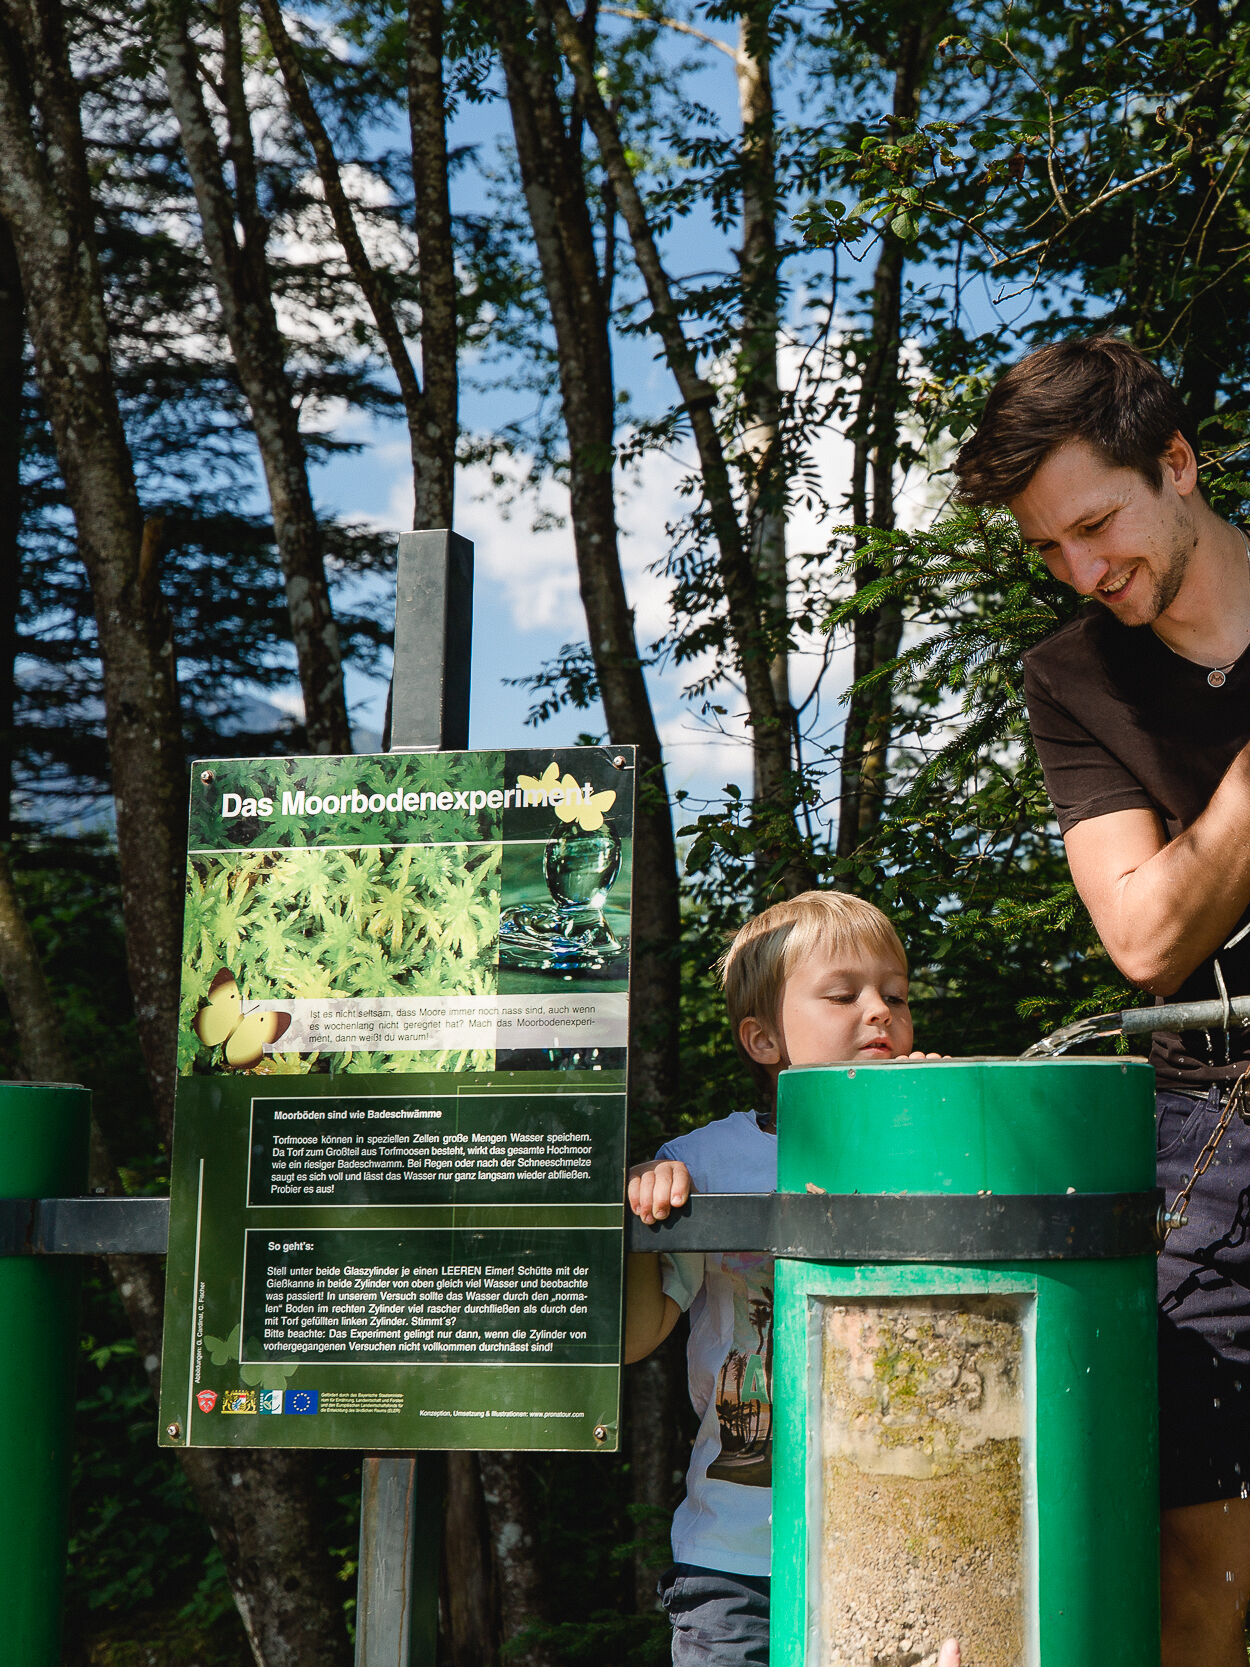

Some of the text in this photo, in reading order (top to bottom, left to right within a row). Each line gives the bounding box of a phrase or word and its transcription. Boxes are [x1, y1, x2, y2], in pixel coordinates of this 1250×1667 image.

[222, 781, 593, 818] Das Moorbodenexperiment
[310, 1004, 595, 1019] Ist es nicht seltsam, dass Moore immer noch nass sind, auch wenn
[324, 1020, 374, 1032] wochenlang
[378, 1019, 398, 1029] nicht
[403, 1019, 440, 1031] geregnet
[445, 1018, 463, 1028] hat?
[469, 1018, 491, 1028] Mach
[496, 1018, 512, 1027] das
[516, 1017, 595, 1029] Moorbodenexperi-
[308, 1031, 428, 1044] ment, dann weißt du warum!
[274, 1109, 442, 1120] Moorböden sind wie Badeschwämme
[272, 1132, 592, 1145] Torfmoose können in speziellen Zellen große Mengen Wasser speichern.
[272, 1147, 284, 1156] Da
[286, 1147, 304, 1156] Torf
[325, 1147, 359, 1156] Großteil
[378, 1146, 429, 1155] Torfmoosen
[431, 1146, 466, 1157] besteht,
[467, 1146, 488, 1155] wirkt
[488, 1145, 505, 1154] das
[507, 1145, 544, 1156] gesamte
[546, 1145, 592, 1154] Hochmoor
[271, 1157, 591, 1170] wie ein riesiger Badeschwamm. Bei Regen oder nach der Schneeschmelze
[270, 1172, 294, 1183] saugt
[308, 1172, 326, 1180] sich
[328, 1171, 343, 1180] voll
[345, 1171, 361, 1180] und
[363, 1171, 383, 1180] lässt
[385, 1171, 401, 1180] das
[403, 1171, 436, 1180] Wasser
[454, 1173, 476, 1182] ganz
[477, 1170, 515, 1182] langsam
[516, 1170, 546, 1179] wieder
[547, 1170, 591, 1179] abfließen.
[270, 1184, 301, 1193] Probier
[315, 1184, 334, 1193] aus!
[268, 1242, 280, 1250] So
[267, 1266, 588, 1278] Stell unter beide Glaszylinder je einen LEEREN Eimer! Schütte mit der
[266, 1279, 314, 1288] Gießkanne
[316, 1279, 325, 1288] in
[327, 1279, 352, 1288] beide
[354, 1279, 390, 1290] Zylinder
[411, 1279, 434, 1288] oben
[436, 1279, 463, 1290] gleich
[465, 1279, 481, 1288] viel
[483, 1279, 518, 1288] Wasser
[520, 1279, 538, 1288] und
[540, 1279, 588, 1288] beobachte
[286, 1291, 323, 1302] passiert!
[326, 1291, 335, 1300] In
[379, 1292, 416, 1300] Versuch
[419, 1292, 443, 1300] sollte
[445, 1292, 463, 1300] das
[465, 1292, 500, 1300] Wasser
[502, 1292, 528, 1300] durch
[531, 1292, 548, 1300] den
[285, 1304, 314, 1313] Boden
[317, 1304, 328, 1313] im
[331, 1304, 365, 1313] rechten
[368, 1304, 405, 1315] Zylinder
[407, 1304, 423, 1313] viel
[427, 1304, 461, 1313] rascher
[463, 1304, 519, 1313] durchfließen
[523, 1304, 537, 1313] als
[540, 1304, 566, 1313] durch
[569, 1304, 587, 1313] den
[264, 1316, 278, 1325] mit
[280, 1316, 299, 1325] Torf
[300, 1316, 338, 1327] gefüllten
[341, 1316, 367, 1325] linken
[369, 1316, 409, 1327] Zylinder.
[264, 1329, 284, 1338] Bitte
[287, 1329, 326, 1338] beachte:
[328, 1329, 347, 1338] Das
[350, 1329, 400, 1340] Experiment
[403, 1329, 434, 1340] gelingt
[455, 1329, 481, 1340] dann,
[511, 1329, 526, 1338] die
[529, 1329, 566, 1341] Zylinder
[263, 1341, 553, 1353] vorhergegangenen Versuchen nicht vollkommen durchnässt sind!
